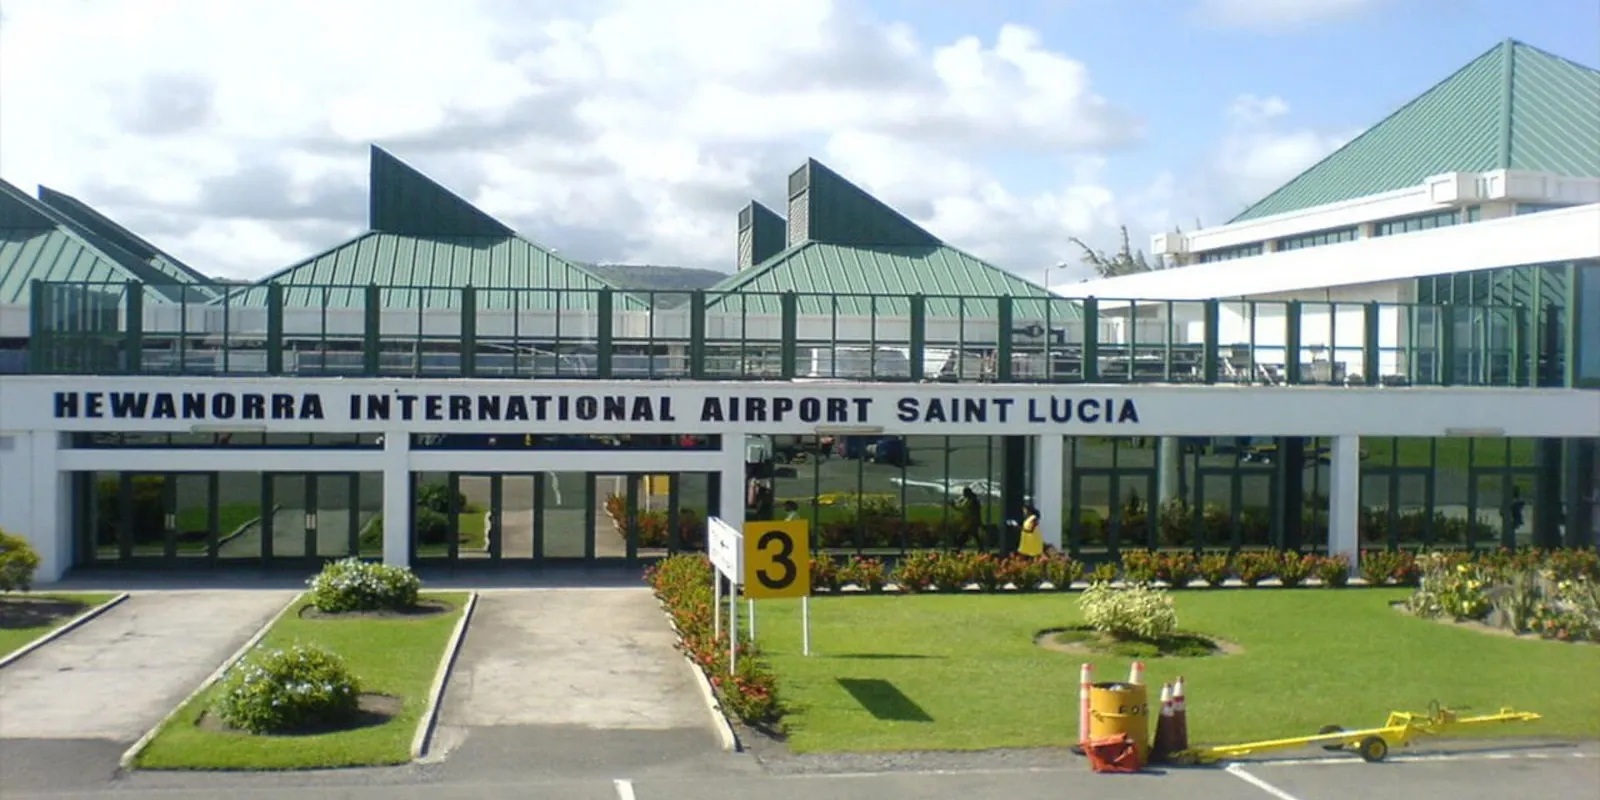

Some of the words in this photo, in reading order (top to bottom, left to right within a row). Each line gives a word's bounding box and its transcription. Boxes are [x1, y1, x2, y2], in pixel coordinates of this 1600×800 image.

[53, 391, 325, 420] HEWANORRA
[349, 393, 677, 422] INTERNATIONAL
[700, 396, 875, 423] AIRPORT
[897, 397, 1015, 424] SAINT
[1028, 396, 1139, 424] LUCIA
[756, 530, 797, 590] 3
